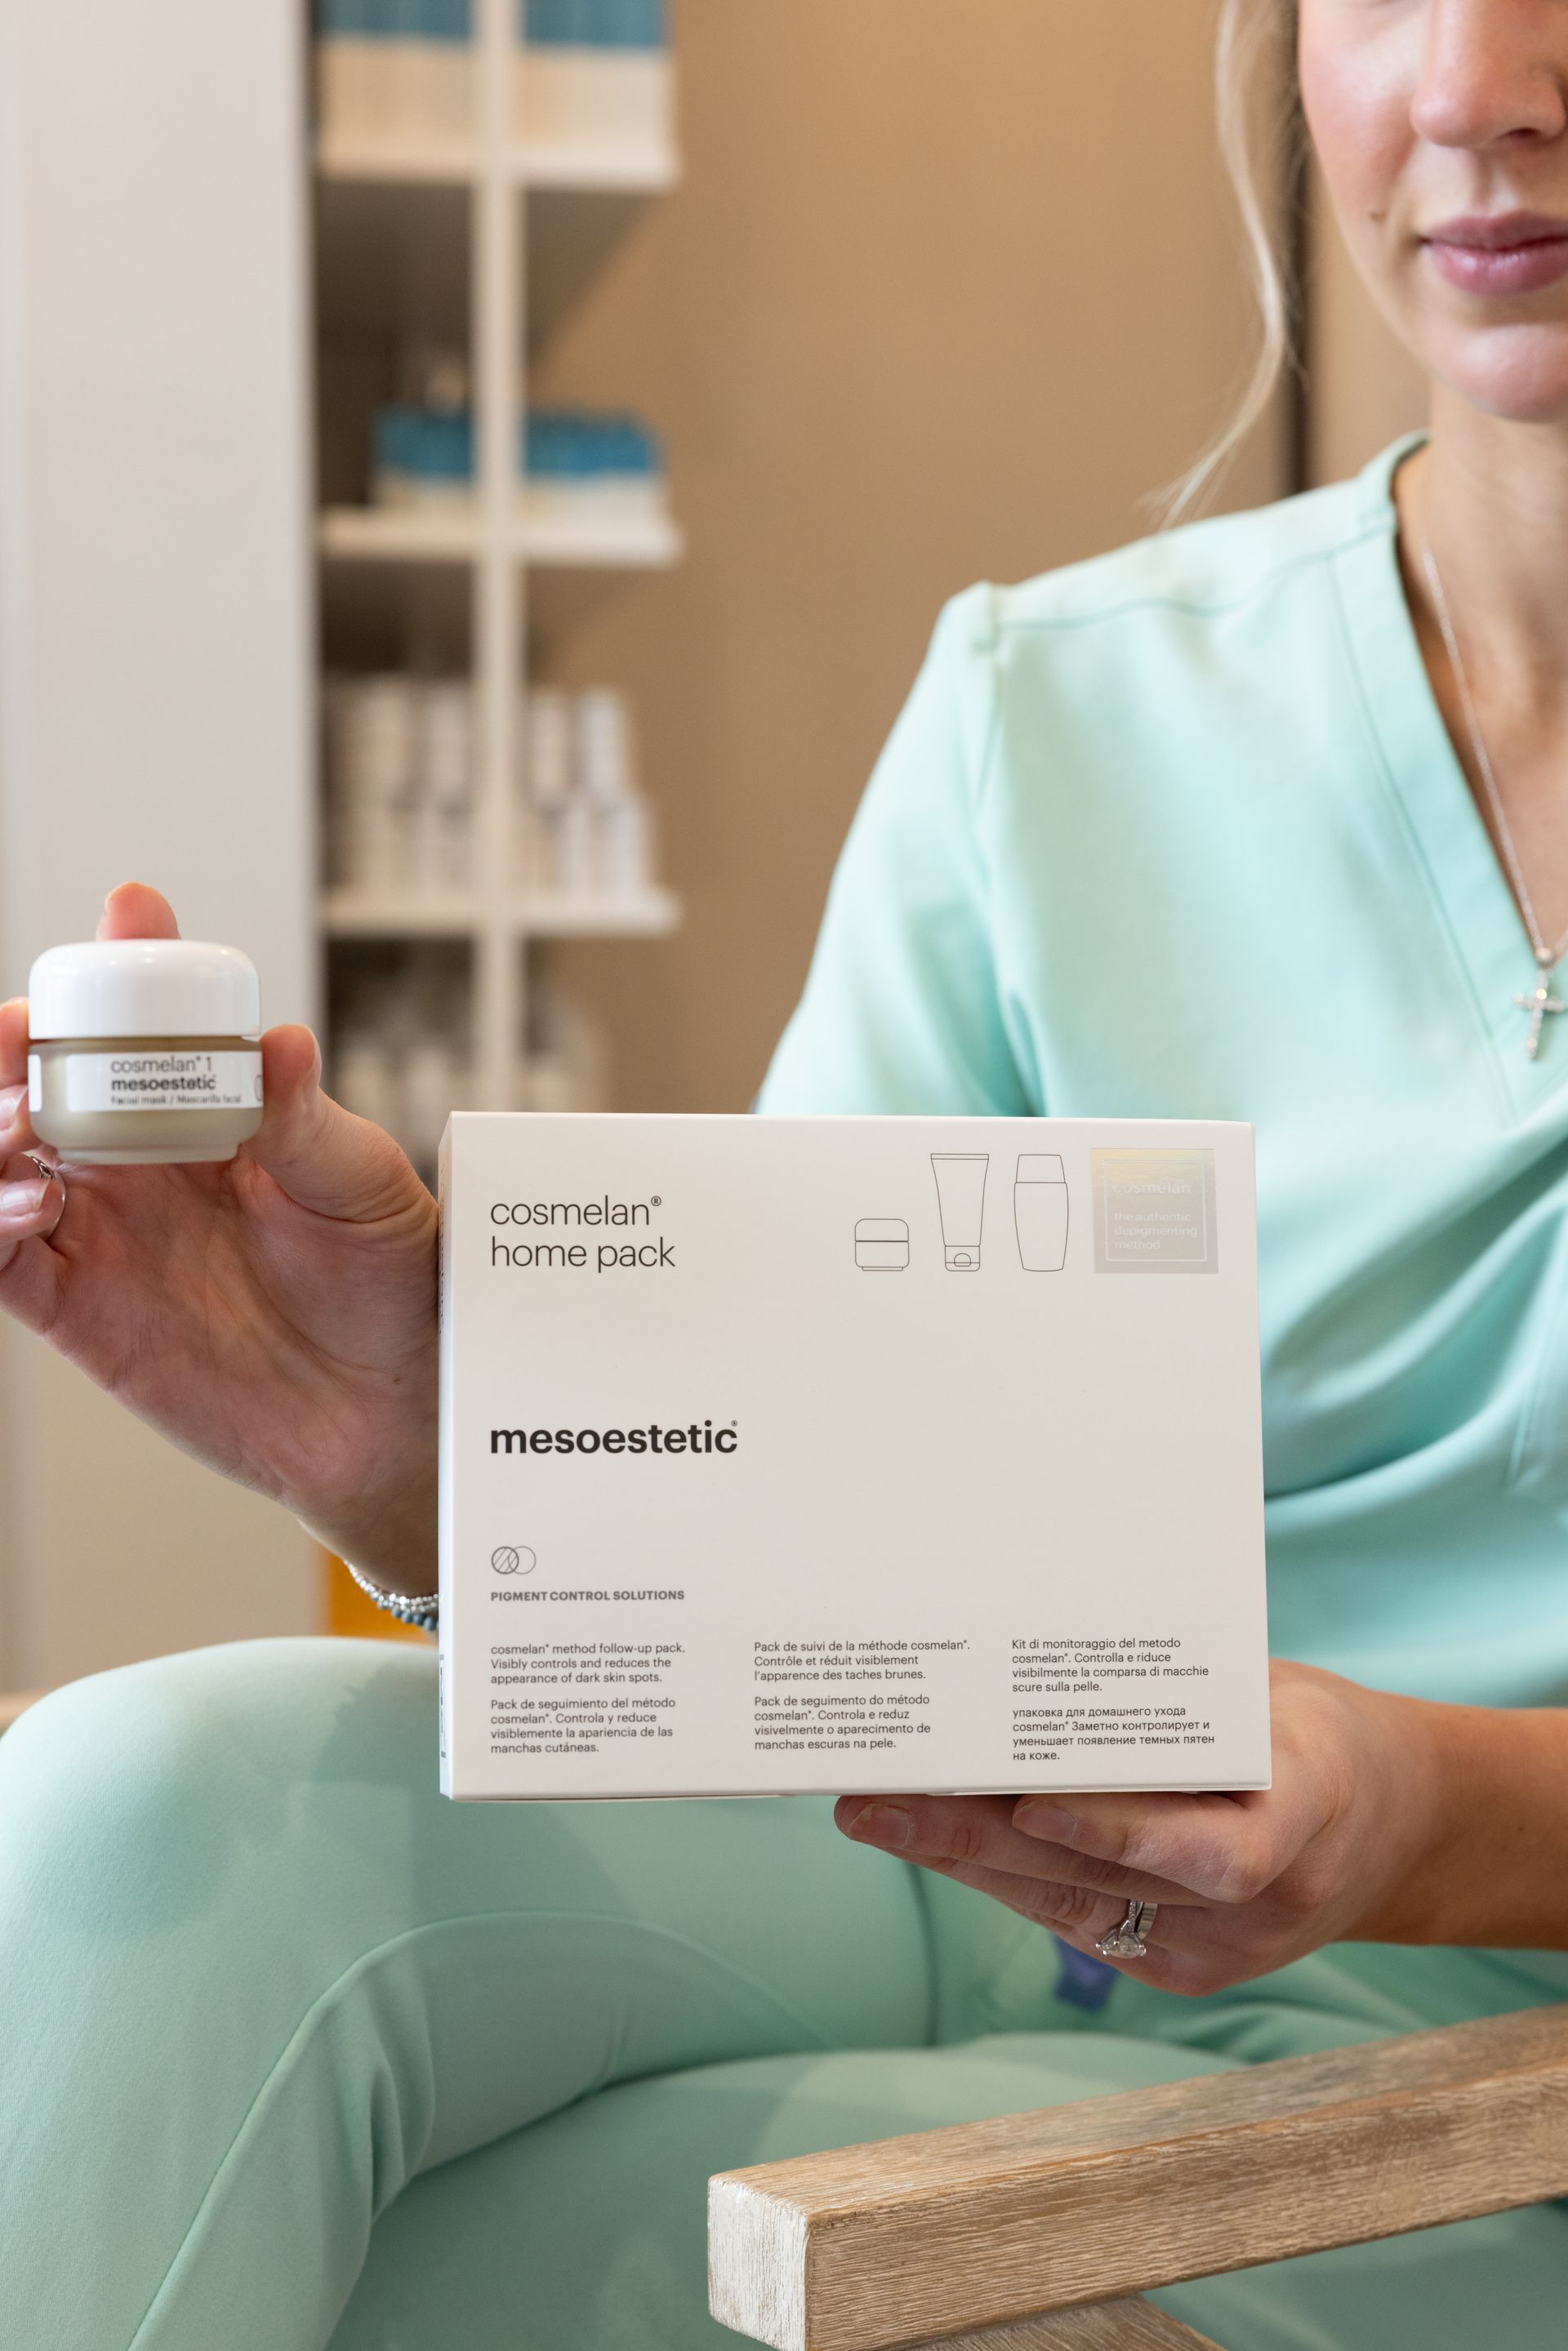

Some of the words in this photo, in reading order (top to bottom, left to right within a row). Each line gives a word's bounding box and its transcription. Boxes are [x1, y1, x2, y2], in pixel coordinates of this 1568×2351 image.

[206, 1056, 212, 1072] 1
[140, 1095, 167, 1105] mask
[1114, 1212, 1134, 1222] the
[1134, 1212, 1192, 1222] authentic
[1114, 1225, 1198, 1239] depigmenting
[1115, 1240, 1161, 1250] method
[491, 1235, 587, 1267] home
[597, 1236, 677, 1274] pack
[490, 1591, 549, 1602] PIGMENT
[549, 1590, 611, 1601] CONTROL
[612, 1590, 685, 1601] SOLUTIONS
[552, 1642, 596, 1654] method
[599, 1642, 653, 1656] follow-up
[655, 1641, 686, 1655] pack.
[754, 1641, 781, 1653] Pack
[782, 1641, 798, 1652] de
[800, 1641, 826, 1652] suivi
[828, 1640, 844, 1652] de
[845, 1640, 856, 1652] la
[858, 1639, 908, 1651] méthode
[1012, 1639, 1027, 1650] Kit
[1028, 1638, 1040, 1650] di
[1042, 1637, 1116, 1651] monitoraggio
[1118, 1636, 1136, 1649] del
[1138, 1636, 1181, 1649] metodo
[490, 1658, 528, 1672] Visibly
[530, 1657, 577, 1669] controls
[580, 1657, 602, 1669] and
[604, 1656, 651, 1668] reduces
[653, 1656, 672, 1668] the
[754, 1654, 804, 1667] Contrôle
[805, 1656, 817, 1667] et
[819, 1654, 853, 1666] réduit
[855, 1654, 920, 1666] visiblement
[1074, 1651, 1125, 1663] Controlla
[1126, 1654, 1134, 1663] e
[1136, 1651, 1172, 1663] riduce
[490, 1674, 559, 1686] appearance
[560, 1672, 573, 1684] of
[575, 1672, 601, 1684] dark
[603, 1672, 626, 1683] skin
[628, 1672, 663, 1685] spots.
[822, 1669, 843, 1681] des
[844, 1668, 883, 1681] taches
[884, 1668, 926, 1680] brunes.
[1012, 1667, 1079, 1678] visibilmente
[1080, 1666, 1090, 1678] la
[1093, 1668, 1147, 1679] comparsa
[1149, 1665, 1160, 1676] di
[1162, 1665, 1209, 1676] macchie
[1012, 1684, 1043, 1693] scure
[1045, 1681, 1071, 1692] sulla
[1072, 1680, 1102, 1694] pelle.
[490, 1698, 518, 1710] Pack
[519, 1698, 536, 1710] de
[537, 1698, 608, 1712] seguimiento
[610, 1697, 629, 1709] del
[631, 1696, 676, 1708] método
[754, 1695, 781, 1707] Pack
[782, 1694, 799, 1707] de
[800, 1694, 867, 1708] seguimento
[868, 1694, 884, 1706] do
[886, 1693, 930, 1705] método
[555, 1712, 604, 1724] Controla
[607, 1715, 614, 1725] y
[617, 1712, 657, 1723] reduce
[817, 1708, 866, 1721] Controla
[868, 1711, 876, 1720] e
[878, 1708, 911, 1720] reduz
[1012, 1708, 1063, 1721] упаковка
[1065, 1708, 1085, 1719] для
[1087, 1708, 1152, 1718] домашнего
[1153, 1707, 1187, 1718] ухода
[490, 1727, 564, 1739] visiblemente
[565, 1727, 576, 1739] la
[578, 1726, 638, 1740] apariencia
[639, 1725, 655, 1738] de
[657, 1725, 674, 1738] las
[754, 1724, 825, 1736] visivelmente
[826, 1725, 835, 1735] o
[836, 1723, 915, 1737] aparecimento
[915, 1721, 931, 1734] de
[1071, 1721, 1120, 1731] Заметно
[1121, 1721, 1200, 1733] контролирует
[1202, 1721, 1210, 1730] и
[490, 1742, 542, 1754] manchas
[544, 1741, 599, 1753] cutáneas.
[754, 1739, 805, 1751] manchas
[807, 1740, 851, 1750] escuras
[853, 1740, 867, 1749] na
[869, 1737, 897, 1751] pele.
[1012, 1737, 1075, 1749] уменьшает
[1076, 1736, 1137, 1746] появление
[1138, 1735, 1181, 1745] темных
[1183, 1735, 1215, 1744] пятен
[1012, 1752, 1027, 1761] на
[1029, 1752, 1061, 1761] коже.
